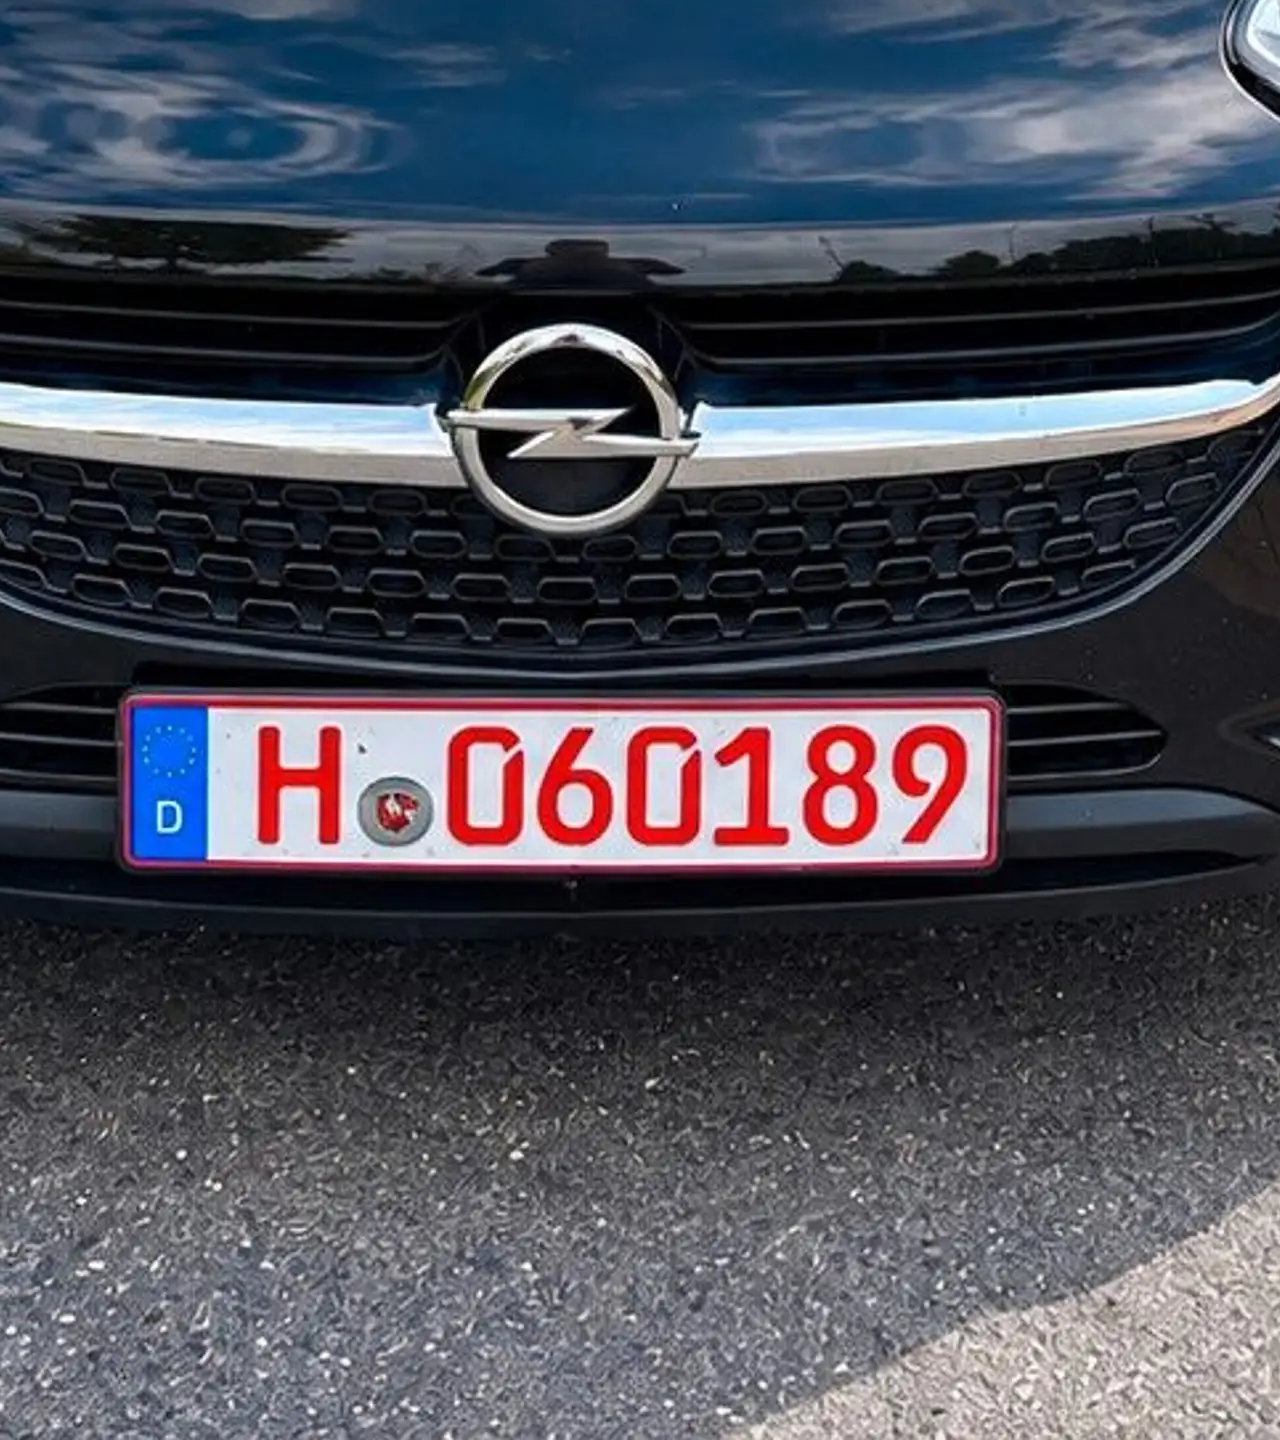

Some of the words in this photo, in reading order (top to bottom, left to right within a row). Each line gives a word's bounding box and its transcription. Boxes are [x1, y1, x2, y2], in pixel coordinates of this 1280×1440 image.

[156, 800, 183, 835] D
[256, 725, 341, 846] H
[446, 724, 969, 847] 060189
